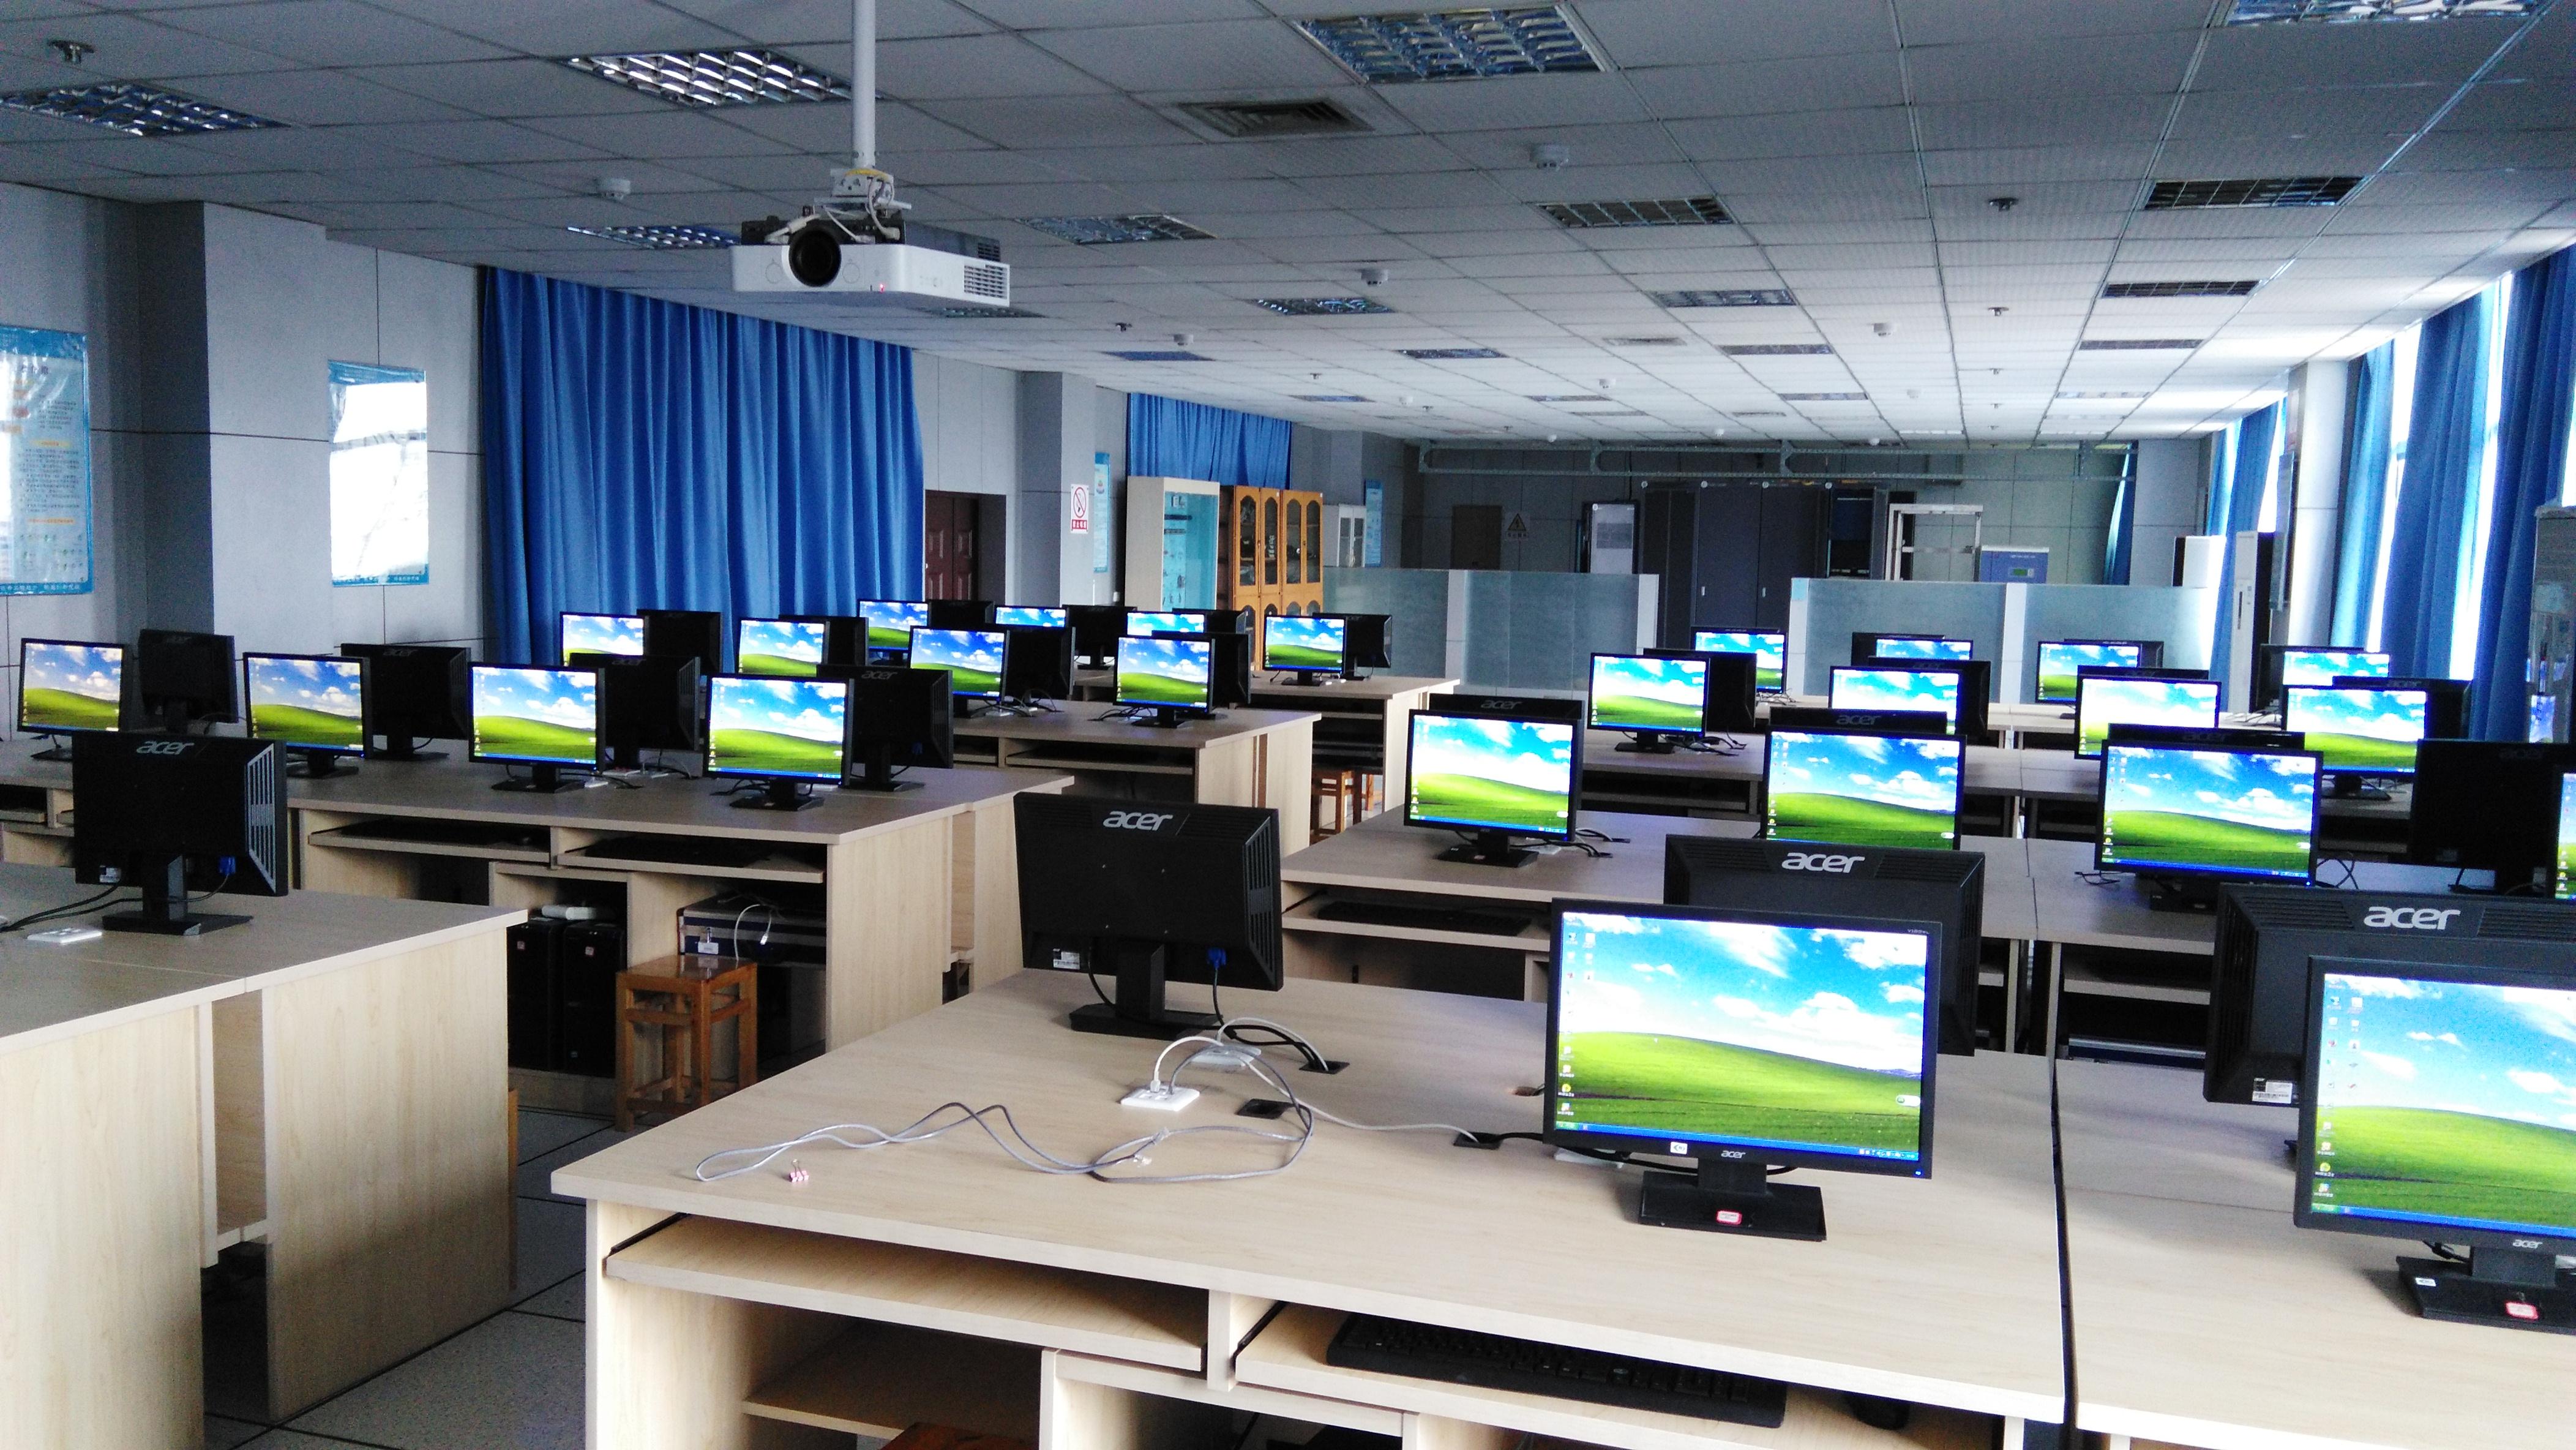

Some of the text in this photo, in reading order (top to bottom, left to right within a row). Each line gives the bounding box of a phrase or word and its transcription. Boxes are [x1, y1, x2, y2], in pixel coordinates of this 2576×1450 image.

[861, 670, 898, 680] acer
[1481, 700, 1522, 710] acer
[1837, 715, 1881, 726] acer
[137, 740, 195, 756] acer
[1103, 811, 1174, 831] acer
[1781, 852, 1865, 873] acer
[2364, 906, 2462, 930] acer
[1720, 1149, 1747, 1159] acer
[2512, 1239, 2543, 1249] acer
